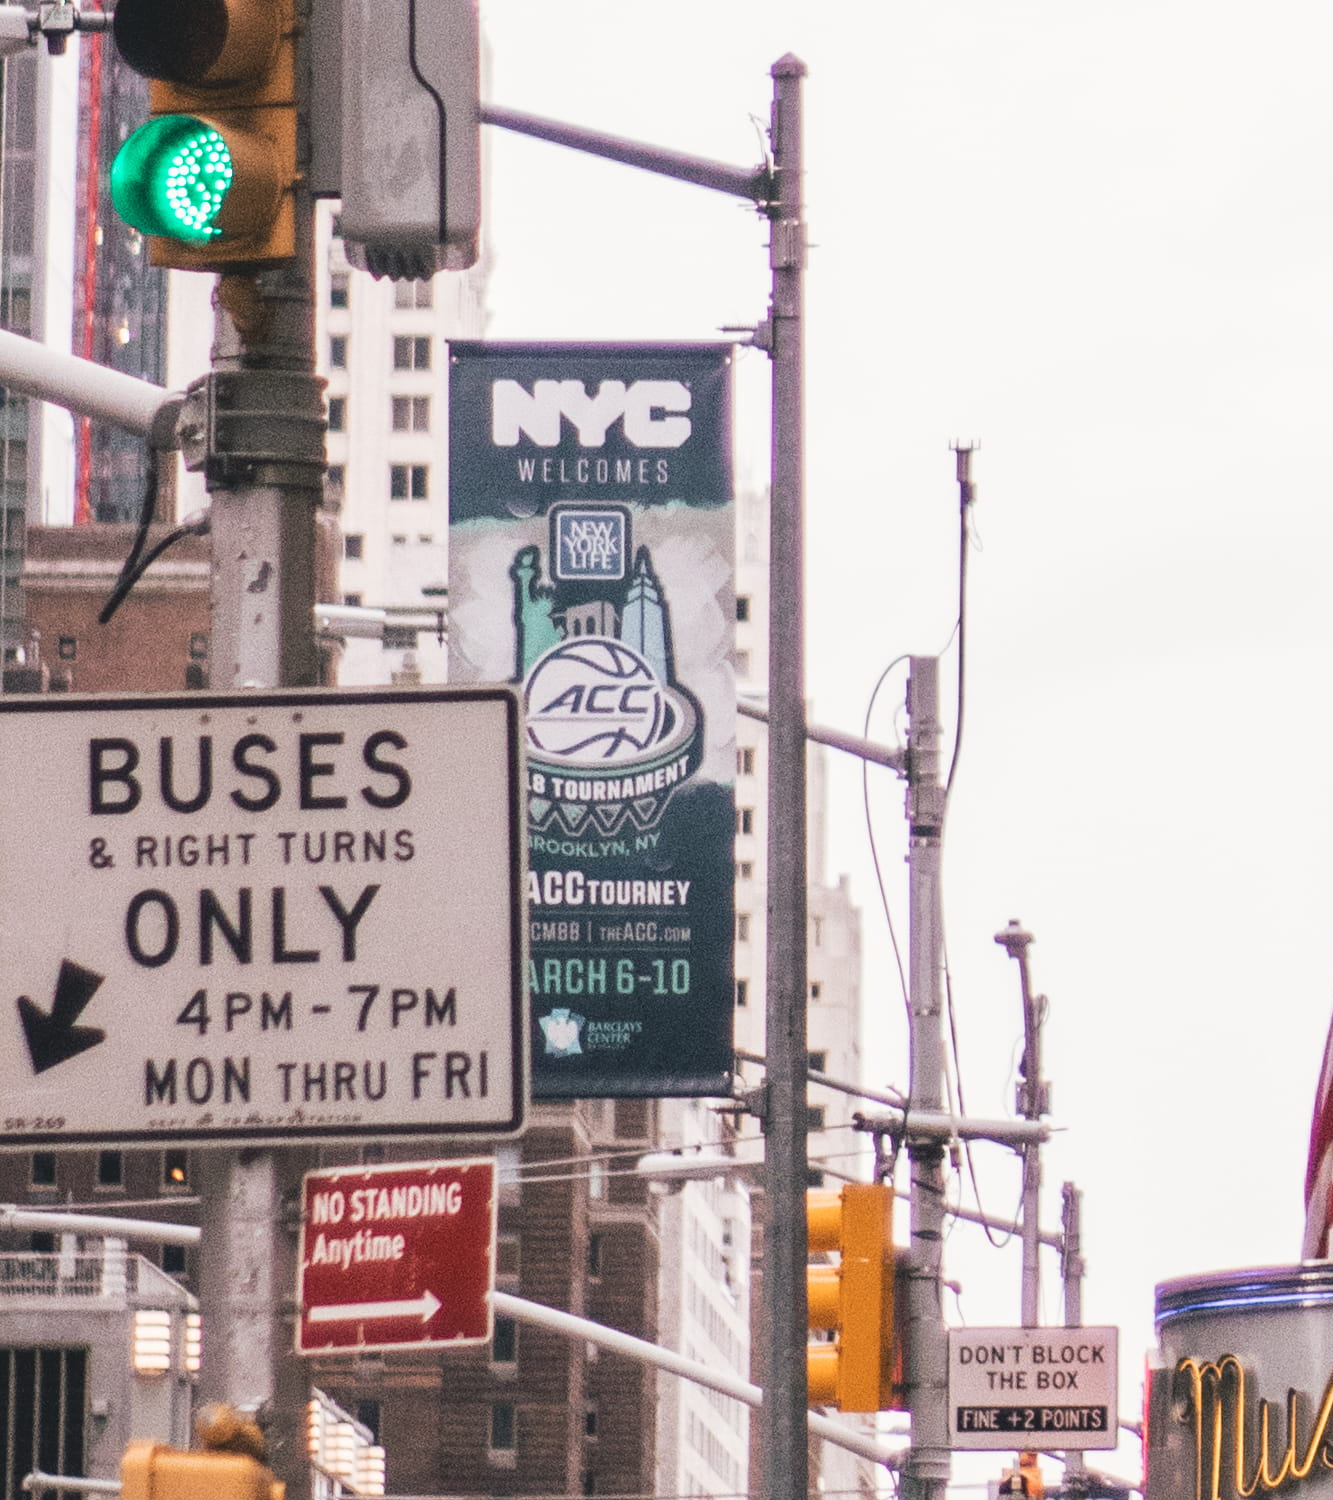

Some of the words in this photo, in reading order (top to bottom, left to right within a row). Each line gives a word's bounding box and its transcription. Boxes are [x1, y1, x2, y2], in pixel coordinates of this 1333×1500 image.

[492, 379, 692, 448] NYC
[518, 458, 669, 484] WELCOMES
[565, 537, 618, 554] YORK
[570, 521, 614, 538] NEW
[571, 553, 612, 570] LIFE
[538, 684, 656, 714] ACC
[88, 729, 413, 817] BUSES
[553, 755, 689, 801] TOURNAMENT
[88, 836, 115, 869] &
[135, 833, 256, 868] RIGHT
[278, 829, 416, 864] TURNS
[635, 833, 660, 851] NY
[527, 870, 691, 906] ACCTOURNEY
[124, 884, 382, 969] ONLY
[528, 958, 606, 995] ARCH
[616, 958, 691, 995] 6-10
[177, 990, 293, 1036] 4PM
[348, 984, 458, 1032] 7PM
[145, 1057, 251, 1106] MON
[278, 1060, 388, 1102] THRU
[411, 1051, 488, 1099] FRI
[312, 1191, 346, 1225] NO
[350, 1182, 463, 1223] STANDING
[311, 1229, 406, 1271] Anytime
[959, 1345, 1024, 1365] DON'T
[1032, 1345, 1105, 1364] BLOCK
[986, 1371, 1028, 1390] THE
[1036, 1371, 1079, 1390] BOX
[962, 1409, 1000, 1430] FINE
[1041, 1409, 1102, 1429] POINTS
